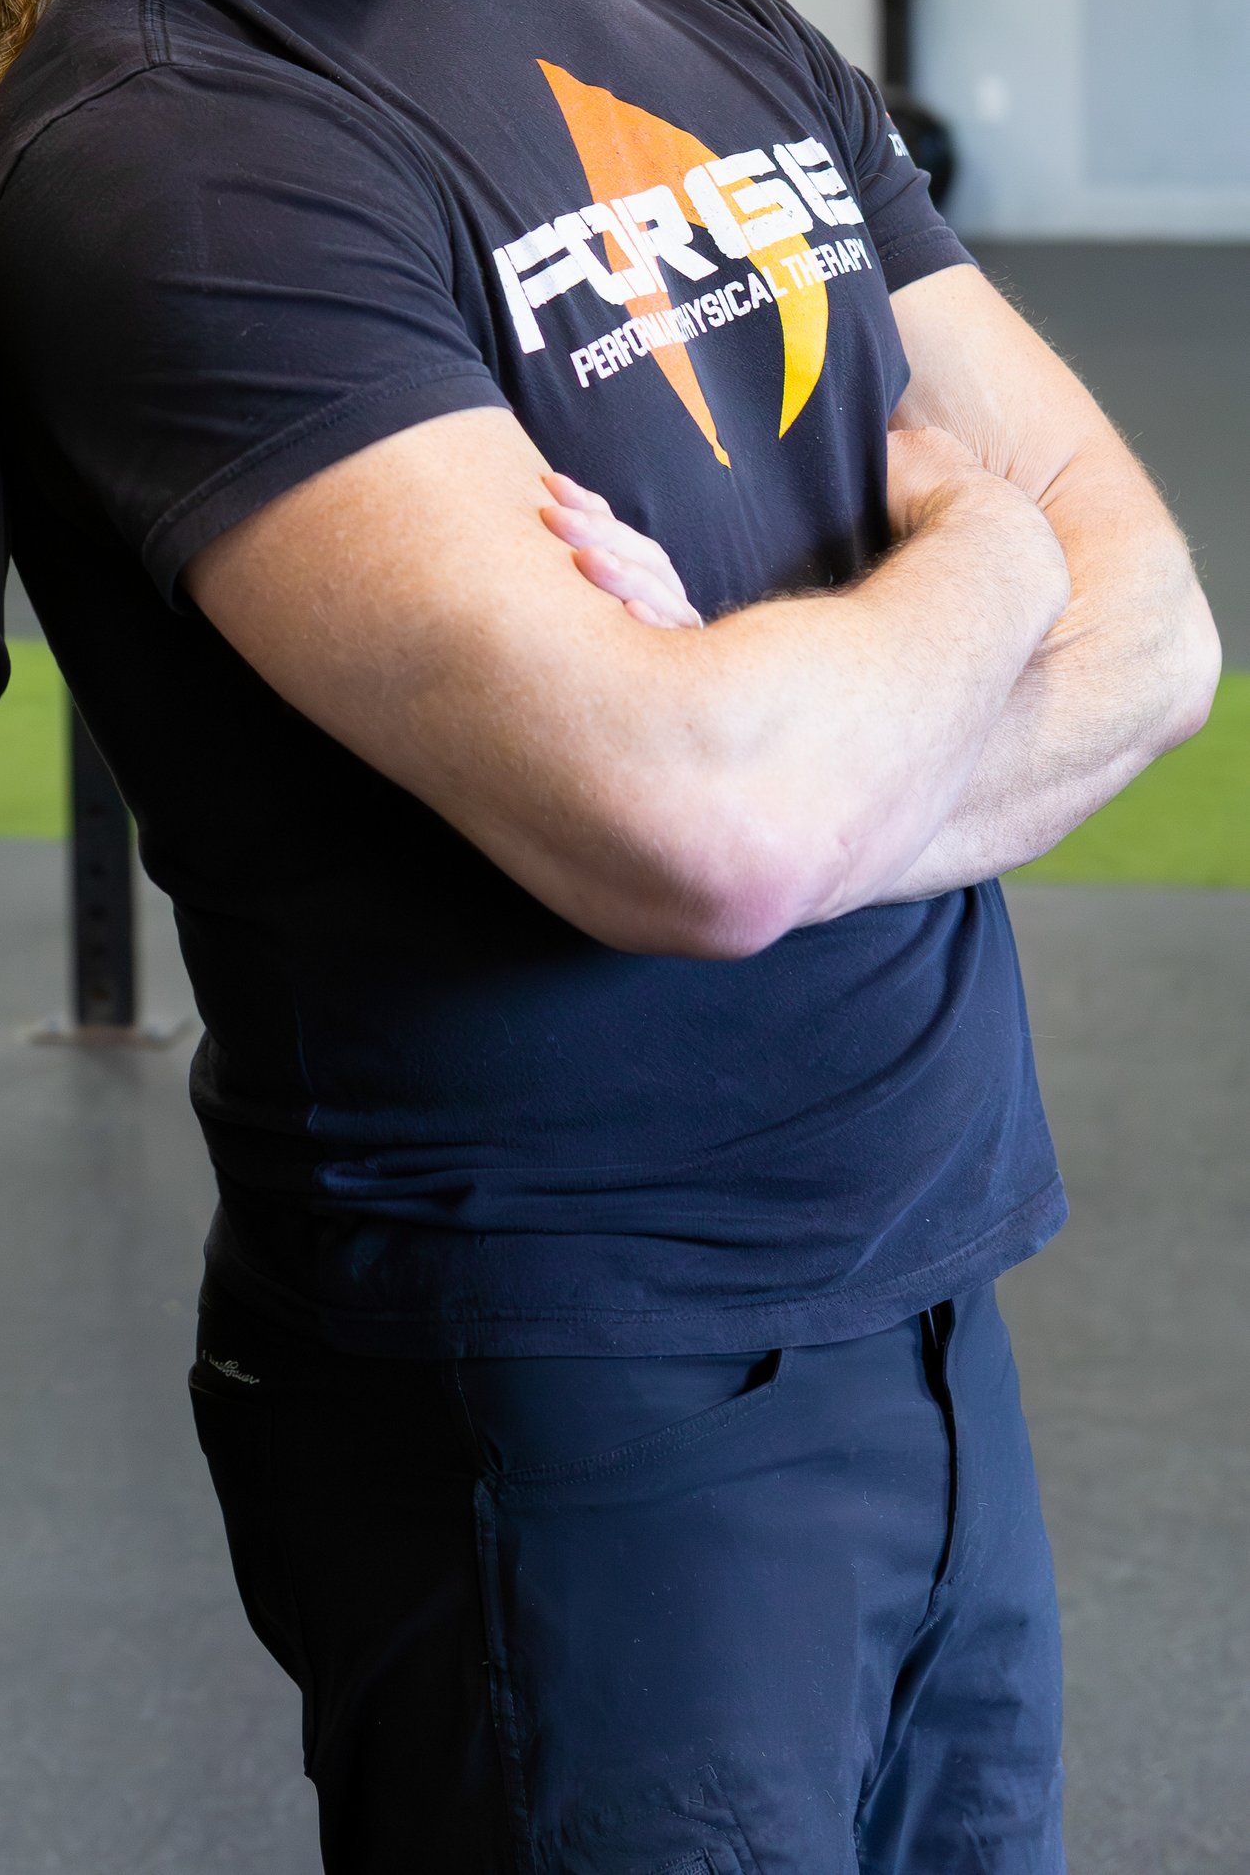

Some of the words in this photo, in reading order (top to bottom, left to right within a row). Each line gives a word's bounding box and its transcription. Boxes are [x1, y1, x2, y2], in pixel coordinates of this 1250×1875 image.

[493, 137, 864, 354] FORGE
[679, 271, 786, 342] HYSICAL
[780, 238, 874, 291] THERAPY
